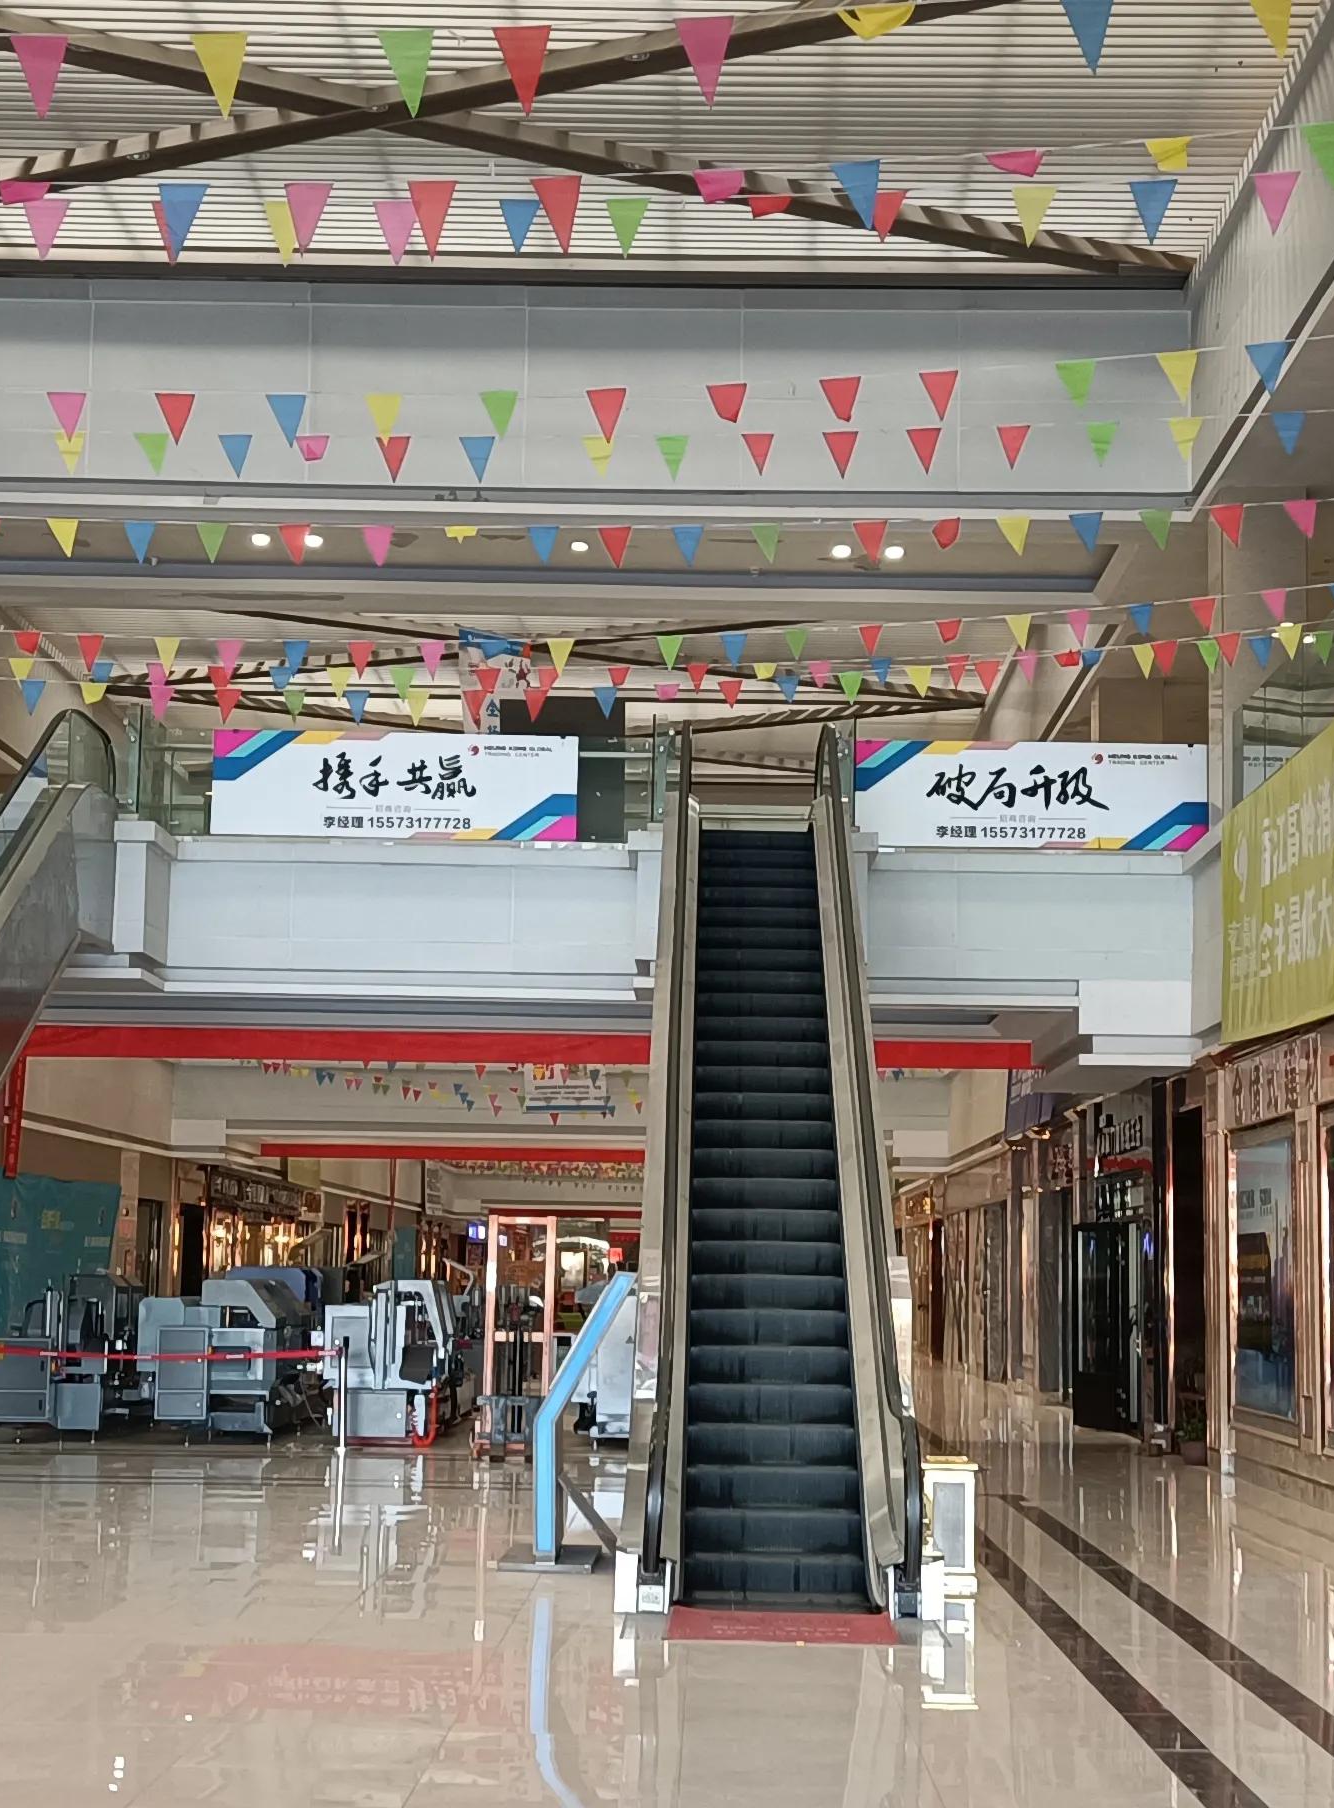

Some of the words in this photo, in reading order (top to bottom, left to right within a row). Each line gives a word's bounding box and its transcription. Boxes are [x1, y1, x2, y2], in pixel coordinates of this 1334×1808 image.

[312, 752, 476, 800] 携手共赢
[926, 763, 1110, 811] 破局升级
[323, 816, 364, 829] 李经理
[369, 816, 471, 829] 15573177728
[936, 826, 977, 838] 李经理
[980, 827, 1086, 839] 15573177728
